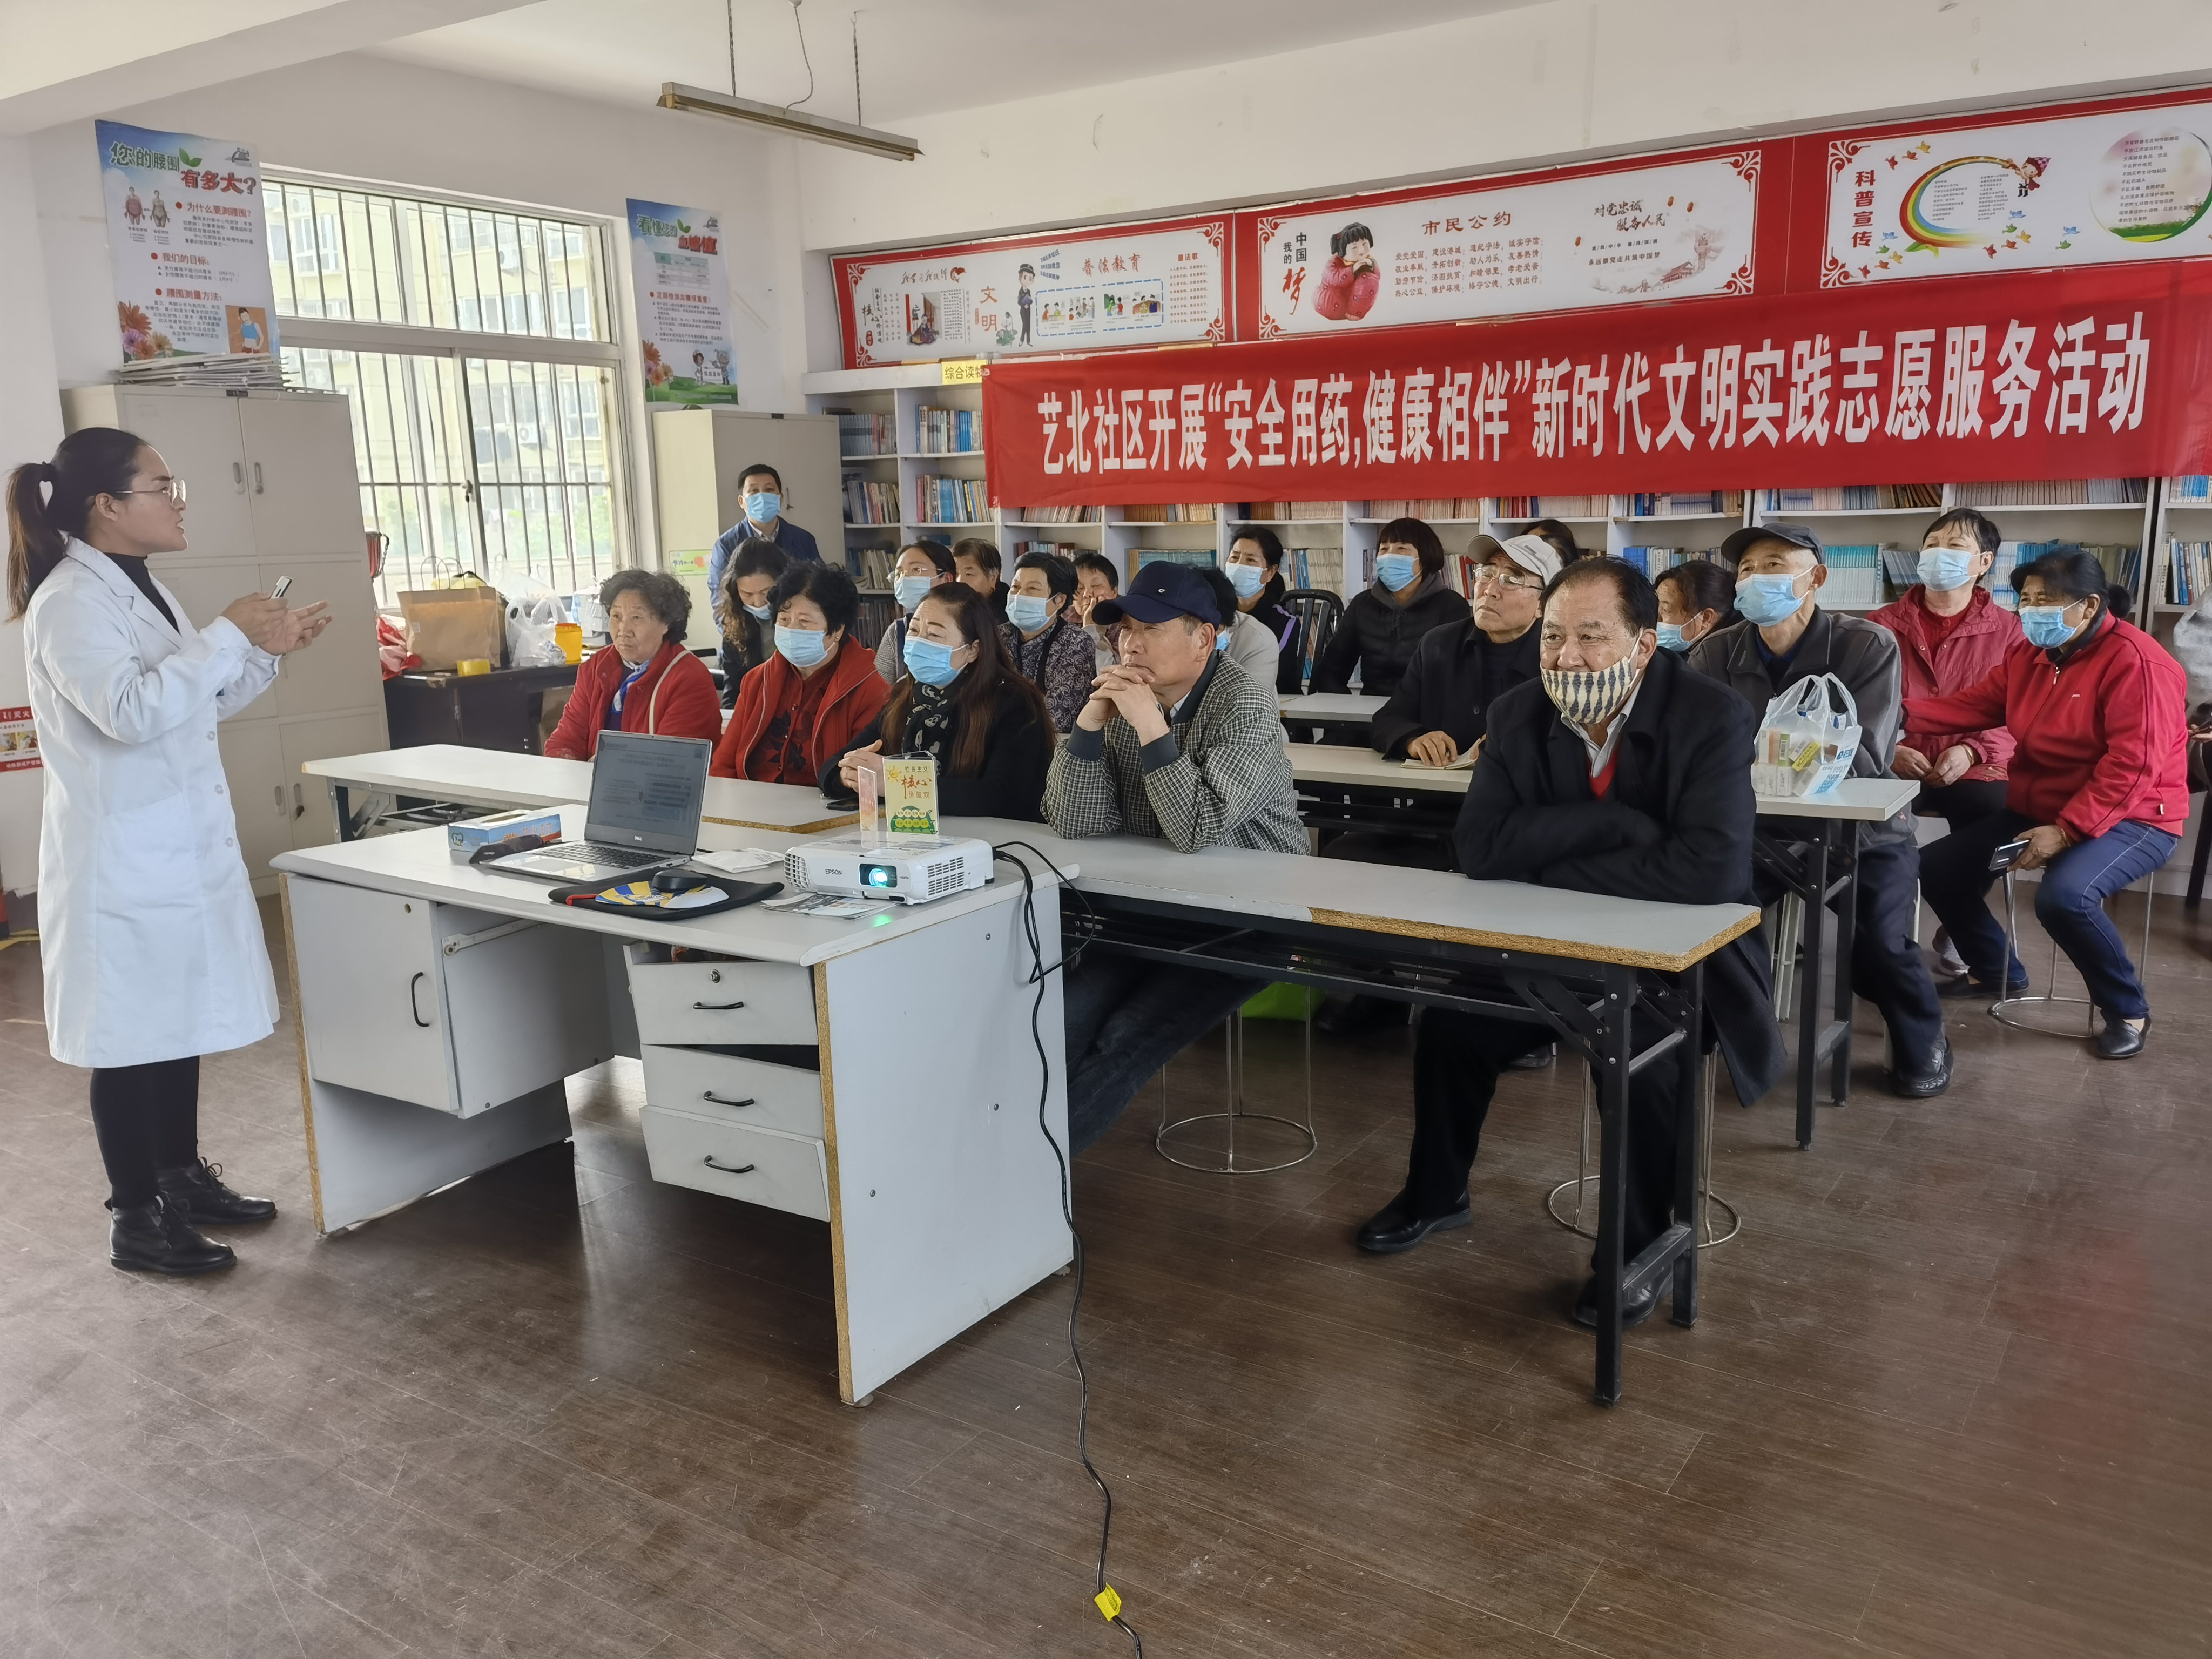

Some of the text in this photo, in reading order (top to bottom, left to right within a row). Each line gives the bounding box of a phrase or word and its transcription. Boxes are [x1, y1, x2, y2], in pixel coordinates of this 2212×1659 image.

[1594, 199, 1643, 217] 对党忠诚
[1851, 170, 1876, 248] 科普宣传
[1421, 211, 1512, 236] 市民公约
[1616, 213, 1665, 232] 服务人民
[1283, 242, 1292, 264] 我的
[1296, 232, 1307, 262] 中国
[1082, 253, 1141, 276] 普法教育
[1282, 266, 1306, 315] 梦
[900, 774, 932, 800] 核心
